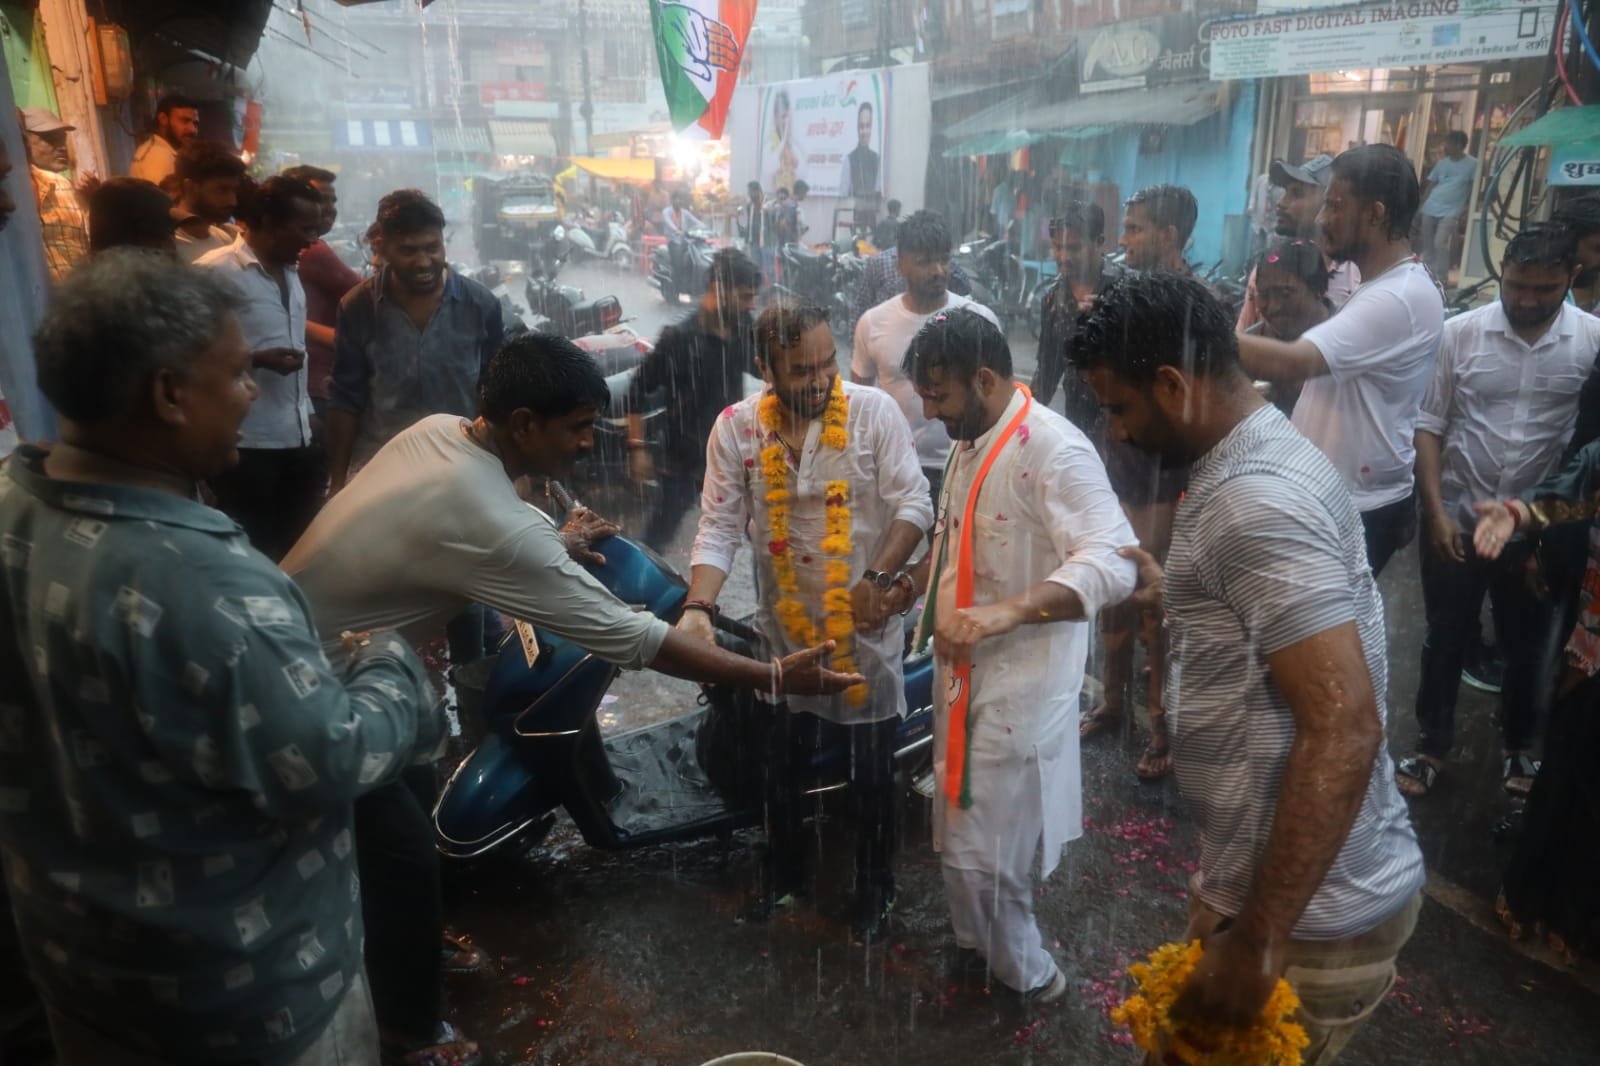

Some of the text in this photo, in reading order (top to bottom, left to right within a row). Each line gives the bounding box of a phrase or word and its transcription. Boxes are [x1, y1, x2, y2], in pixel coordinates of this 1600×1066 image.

[1211, 22, 1249, 40] FOTO
[1253, 17, 1292, 35] FAST
[1295, 9, 1366, 31] DIGITAL
[1371, 0, 1459, 23] IMAGING
